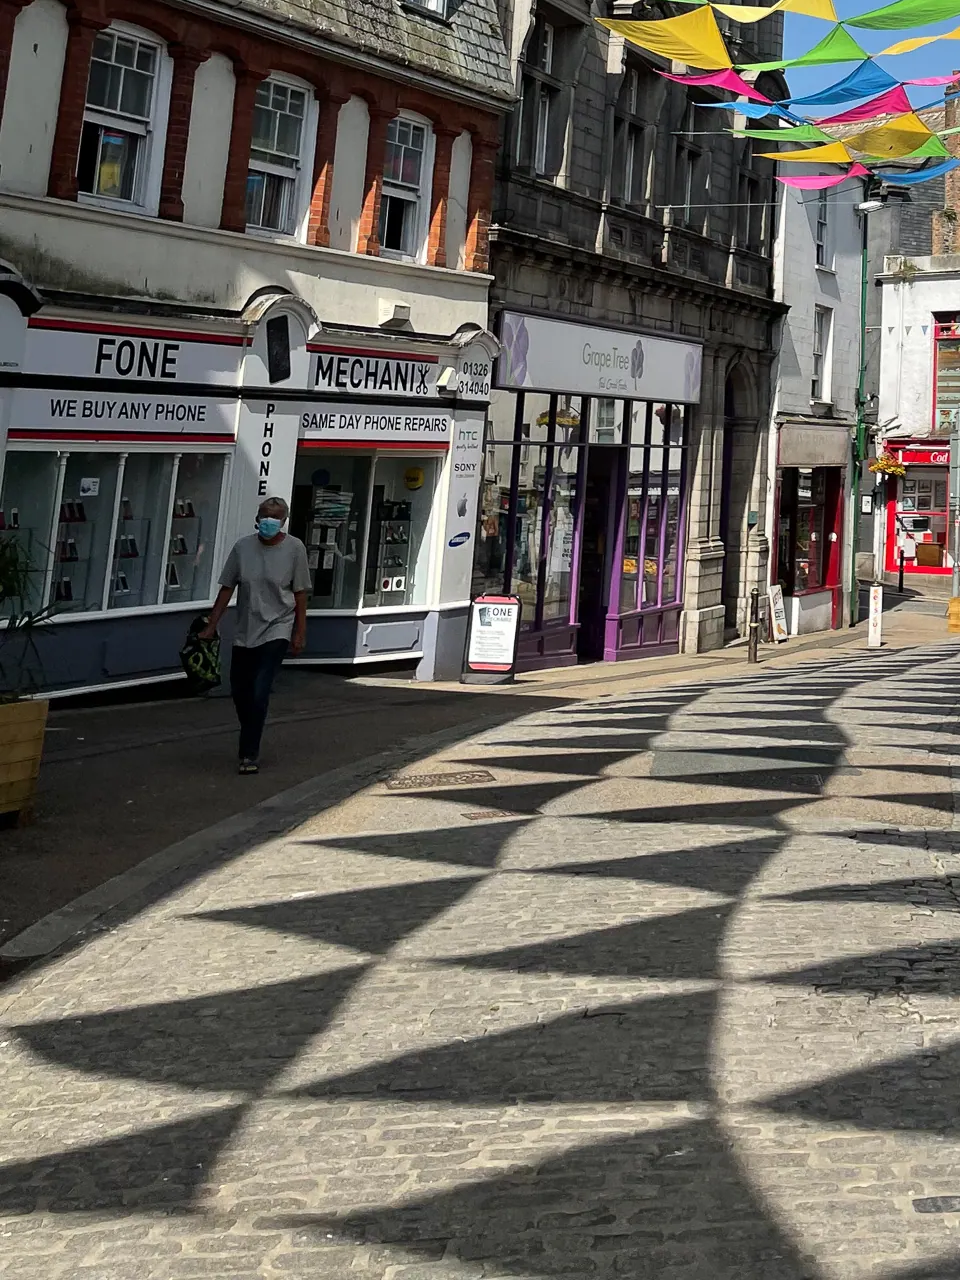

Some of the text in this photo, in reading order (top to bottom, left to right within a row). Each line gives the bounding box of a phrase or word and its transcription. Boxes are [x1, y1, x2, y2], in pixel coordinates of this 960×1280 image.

[95, 338, 180, 379] FONE
[582, 342, 630, 373] Grape Tree
[462, 361, 489, 377] 01326
[458, 380, 490, 396] 314040
[50, 399, 206, 423] WE BUY ANY PHONE
[302, 413, 447, 433] SAME DAY PHONE REPAIRS
[258, 403, 275, 496] PHONE
[930, 451, 949, 463] Cod
[454, 463, 477, 471] SONY
[486, 607, 513, 617] FONE
